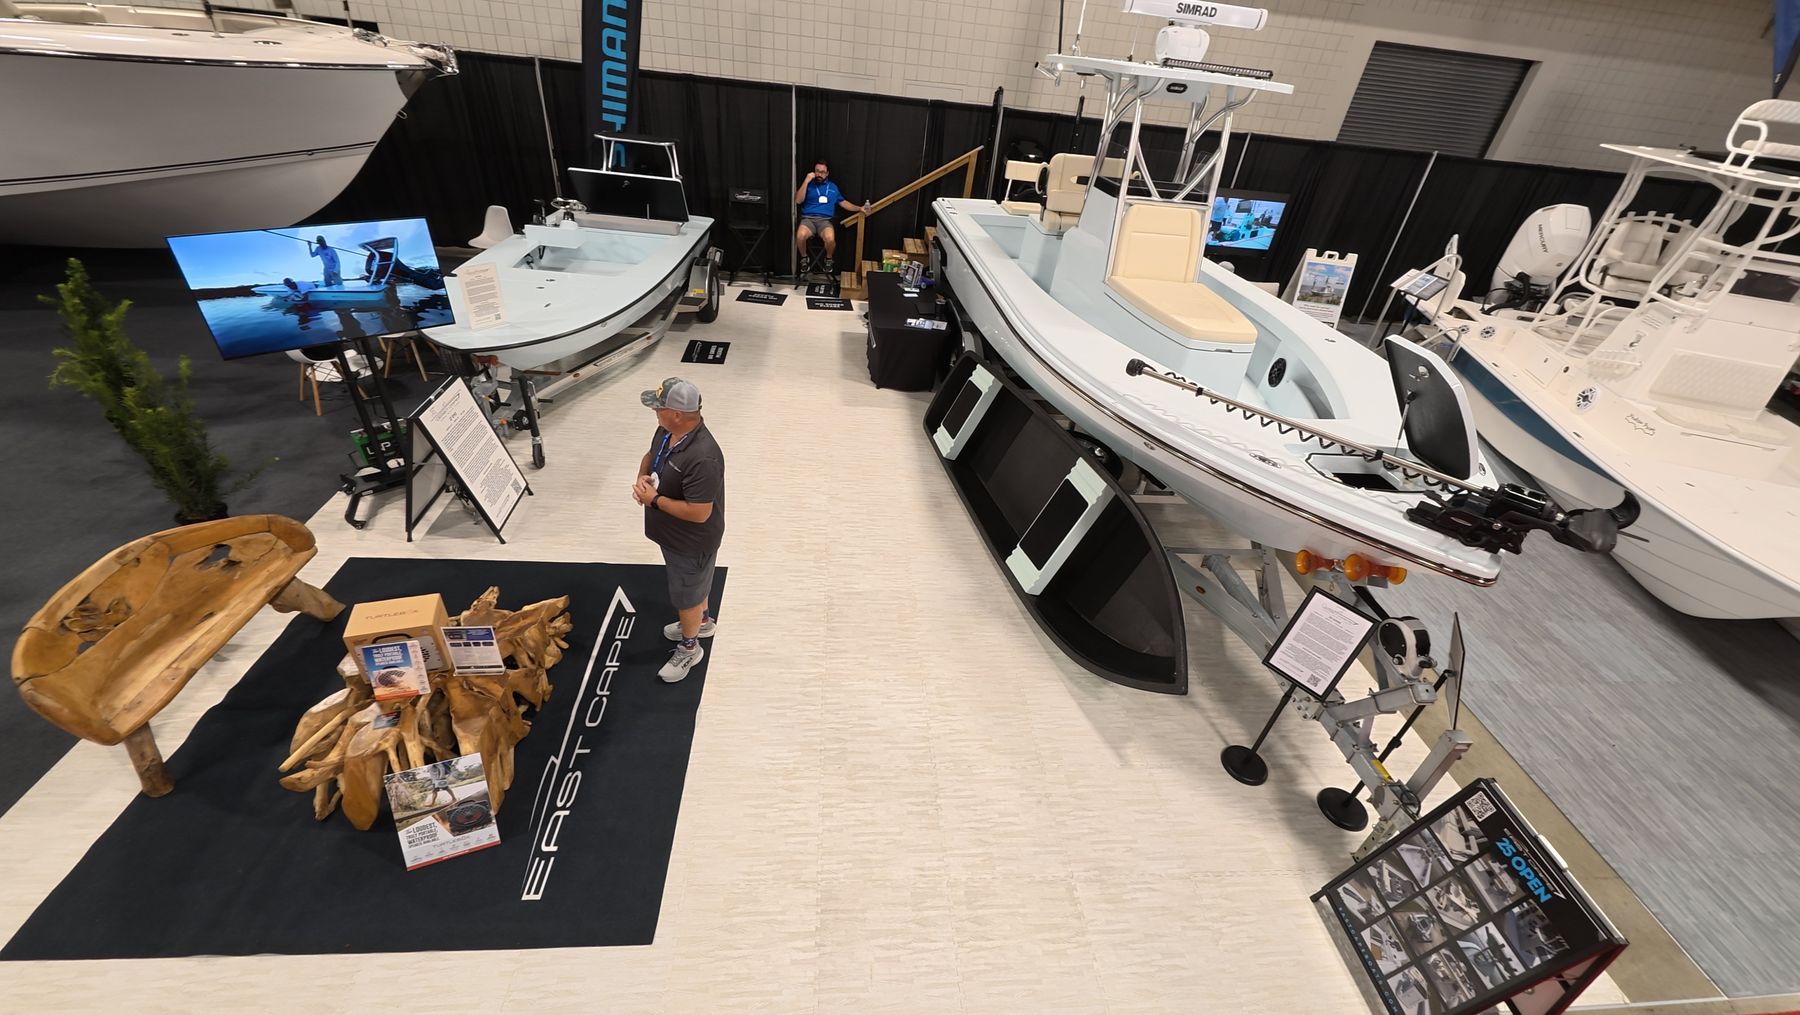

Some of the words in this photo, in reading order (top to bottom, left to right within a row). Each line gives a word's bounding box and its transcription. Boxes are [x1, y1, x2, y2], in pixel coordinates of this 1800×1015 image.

[1176, 2, 1217, 18] SIMRAD
[521, 735, 591, 900] EAST
[585, 616, 636, 728] CAPE
[1496, 837, 1513, 857] 25
[1511, 856, 1552, 903] OPEN
